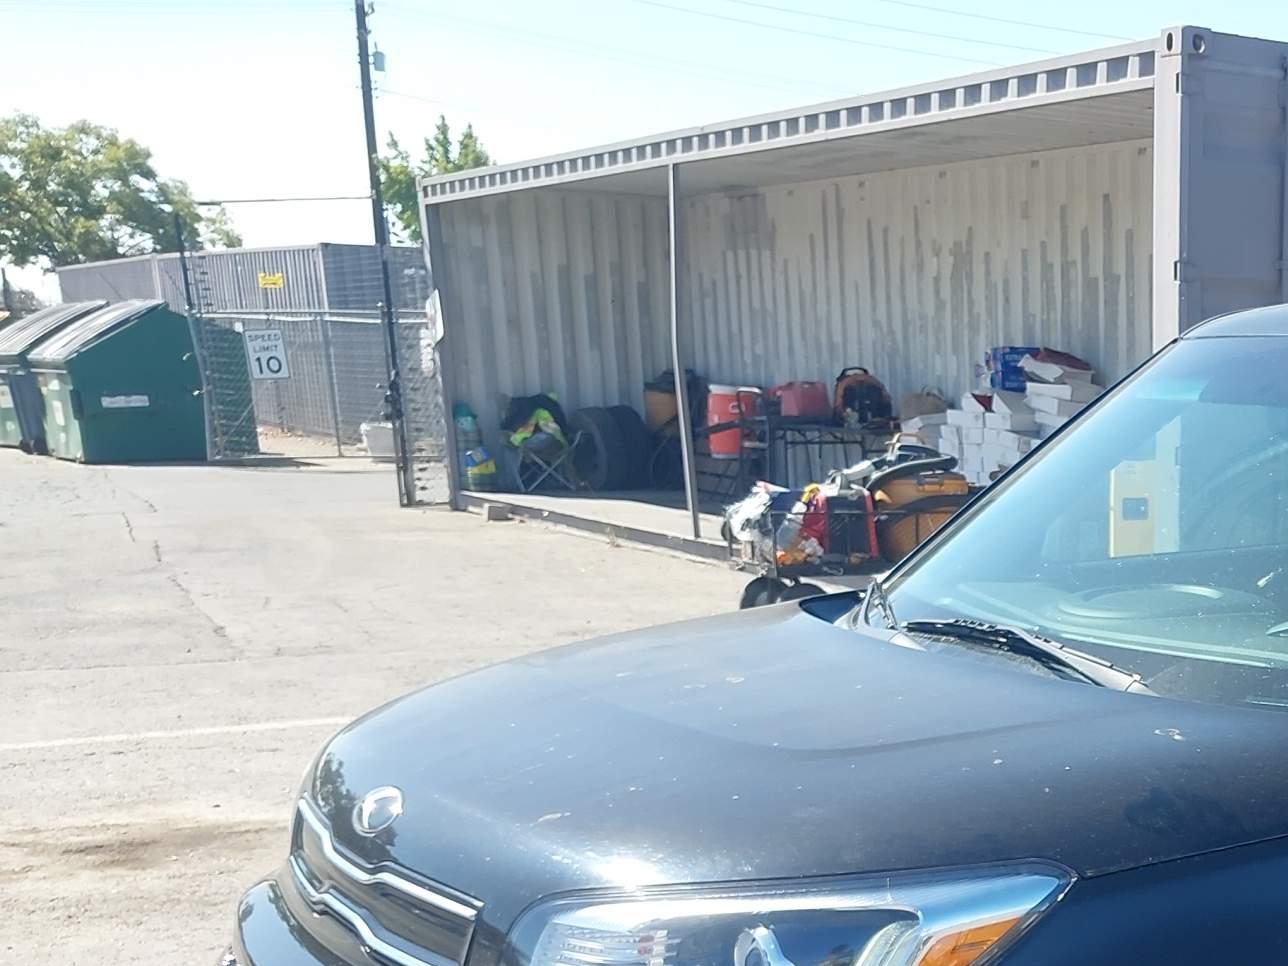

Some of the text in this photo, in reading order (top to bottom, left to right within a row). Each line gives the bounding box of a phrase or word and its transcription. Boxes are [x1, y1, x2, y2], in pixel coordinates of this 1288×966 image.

[247, 333, 281, 343] SPEED
[252, 344, 279, 354] LIMIT
[255, 355, 283, 375] 10
